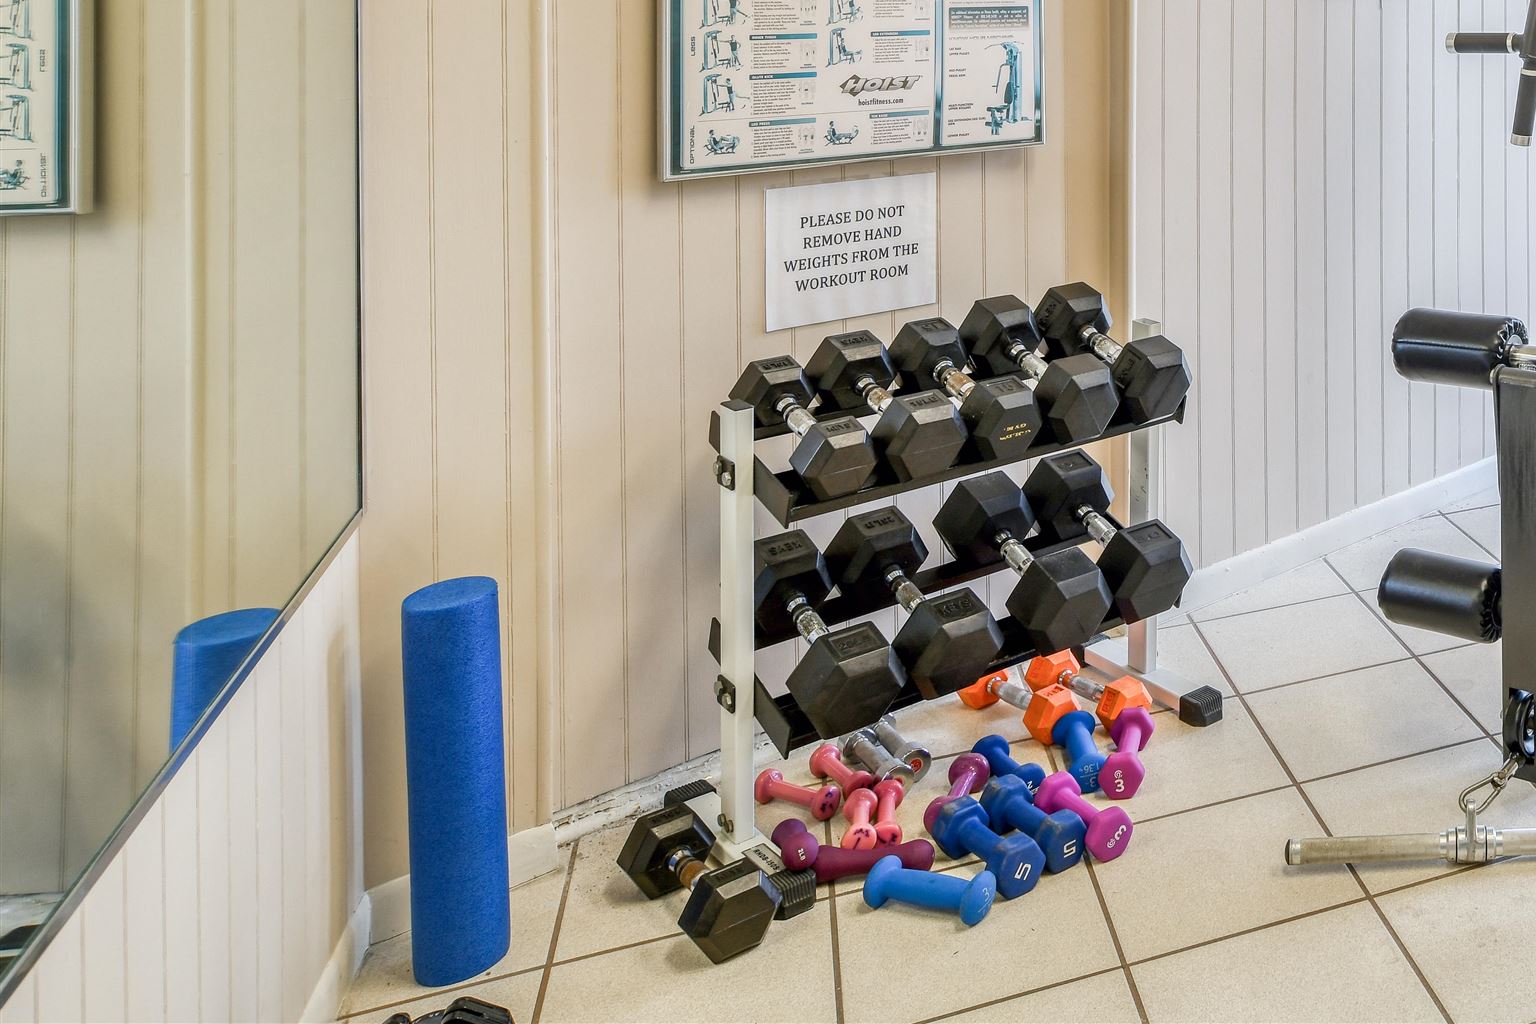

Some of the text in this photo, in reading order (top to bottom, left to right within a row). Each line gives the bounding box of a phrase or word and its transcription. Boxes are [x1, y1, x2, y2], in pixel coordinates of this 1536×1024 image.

[841, 75, 921, 94] HOIST
[858, 98, 904, 106] hoistfitness.com
[800, 204, 905, 229] PLEASE DO NOT
[803, 225, 902, 249] REMOVE HAND
[784, 243, 919, 273] WEIGHTS FROM THE
[795, 264, 909, 292] WORKOUT ROOM
[1115, 779, 1125, 792] 3
[1114, 824, 1127, 840] 3
[1063, 839, 1077, 859] 5
[1014, 862, 1032, 881] 5
[982, 887, 990, 902] 3
